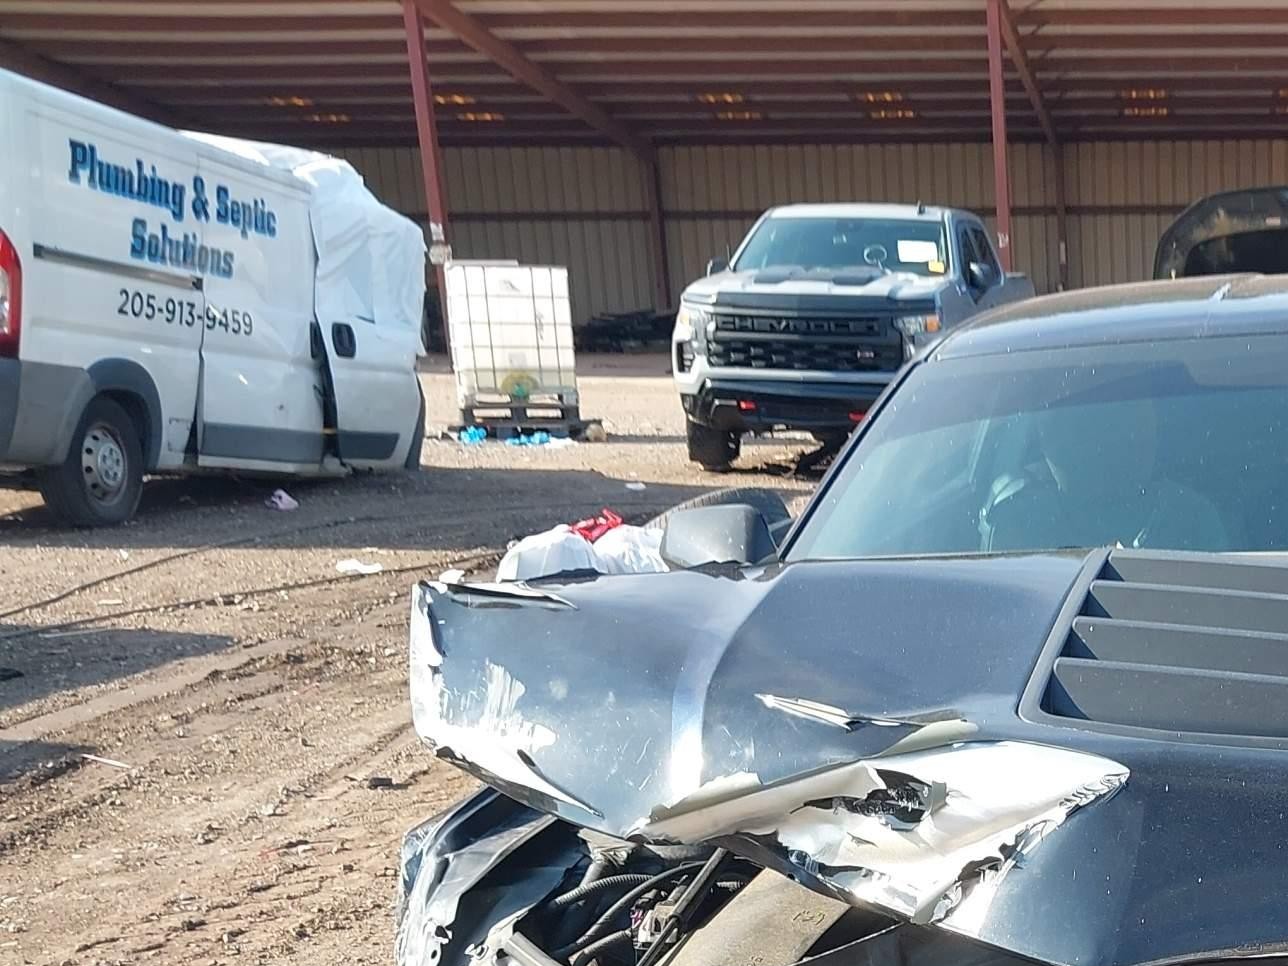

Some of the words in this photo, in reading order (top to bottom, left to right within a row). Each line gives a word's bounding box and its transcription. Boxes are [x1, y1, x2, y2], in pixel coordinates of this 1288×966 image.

[68, 137, 186, 222] Plumbing
[191, 175, 210, 223] &
[216, 184, 277, 239] Septic
[130, 217, 234, 279] Solutions
[117, 288, 253, 336] 205-913-9459
